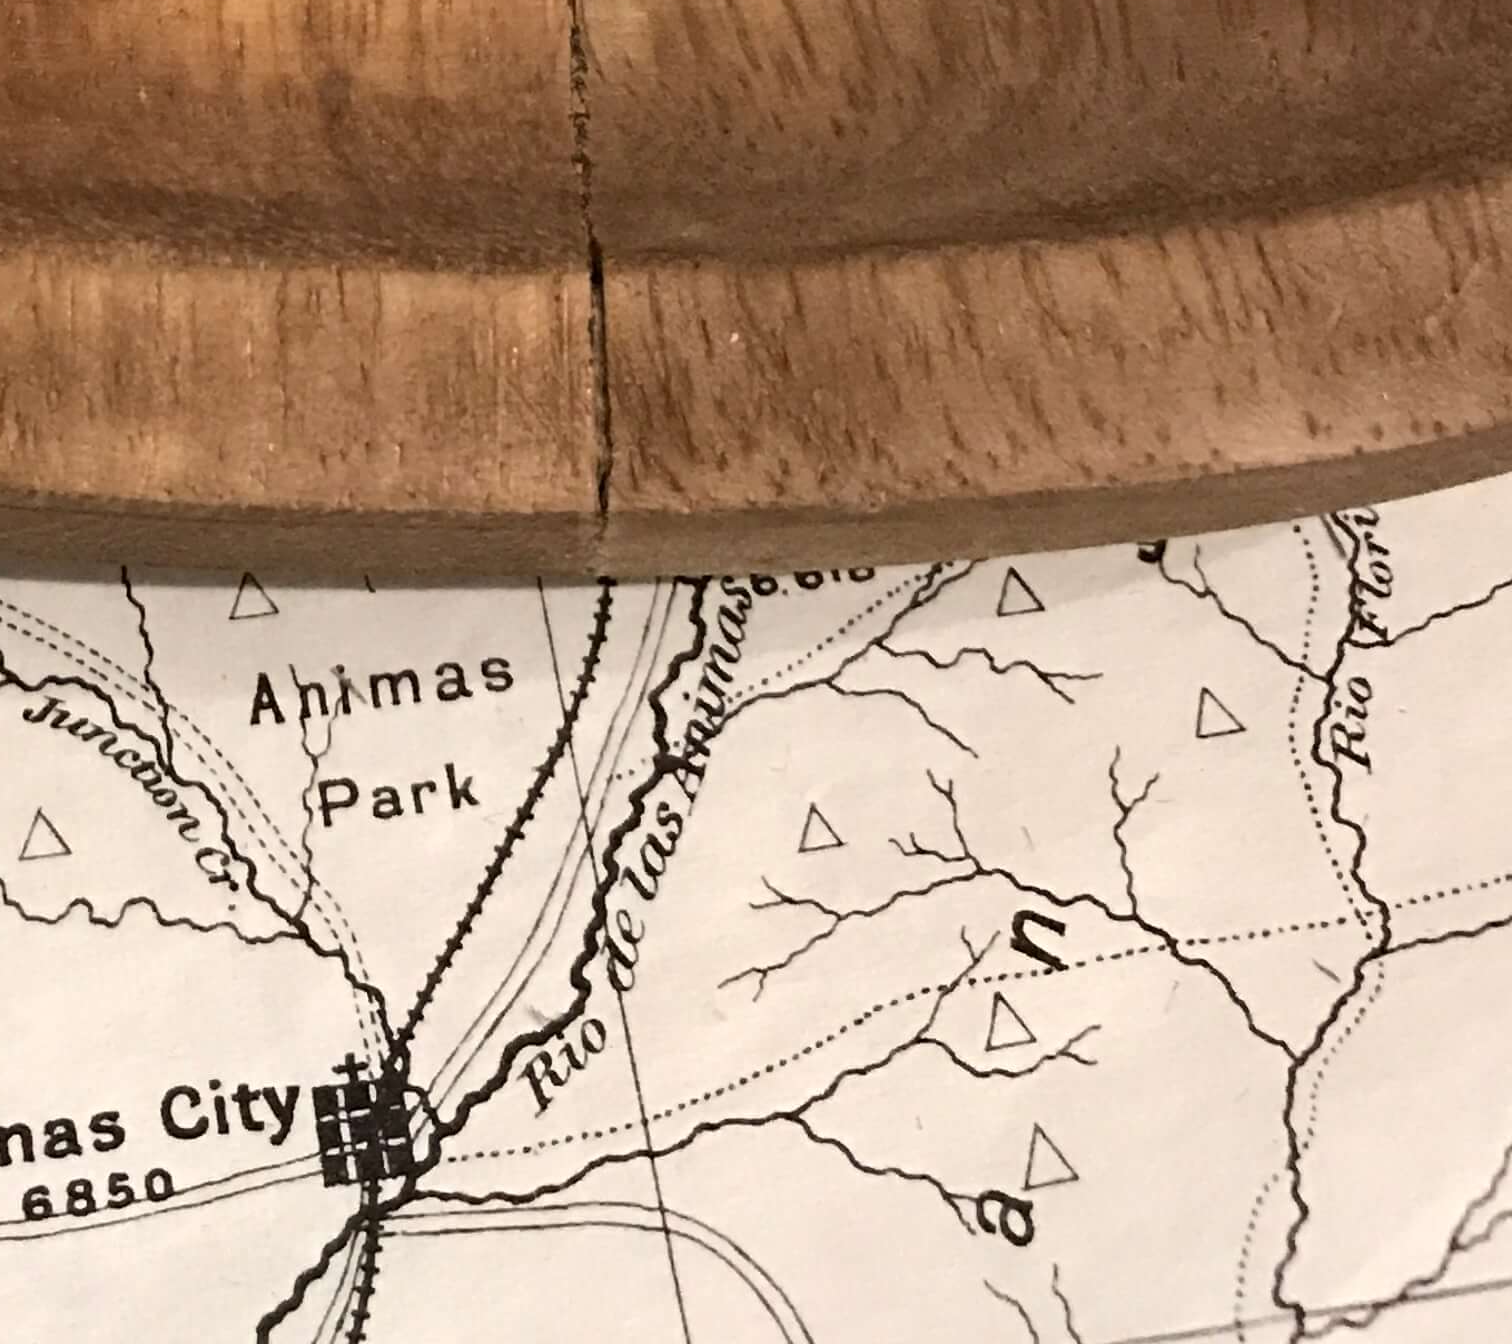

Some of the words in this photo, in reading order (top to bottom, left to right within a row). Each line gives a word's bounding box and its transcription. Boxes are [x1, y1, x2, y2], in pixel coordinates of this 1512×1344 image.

[250, 657, 515, 726] Animas
[1329, 676, 1373, 776] Rio
[22, 695, 201, 843] Junction
[318, 762, 481, 828] Park
[620, 801, 684, 901] las
[600, 909, 645, 992] de
[517, 1018, 607, 1119] Rio
[161, 1079, 300, 1146] City
[22, 1168, 177, 1220] 6850
